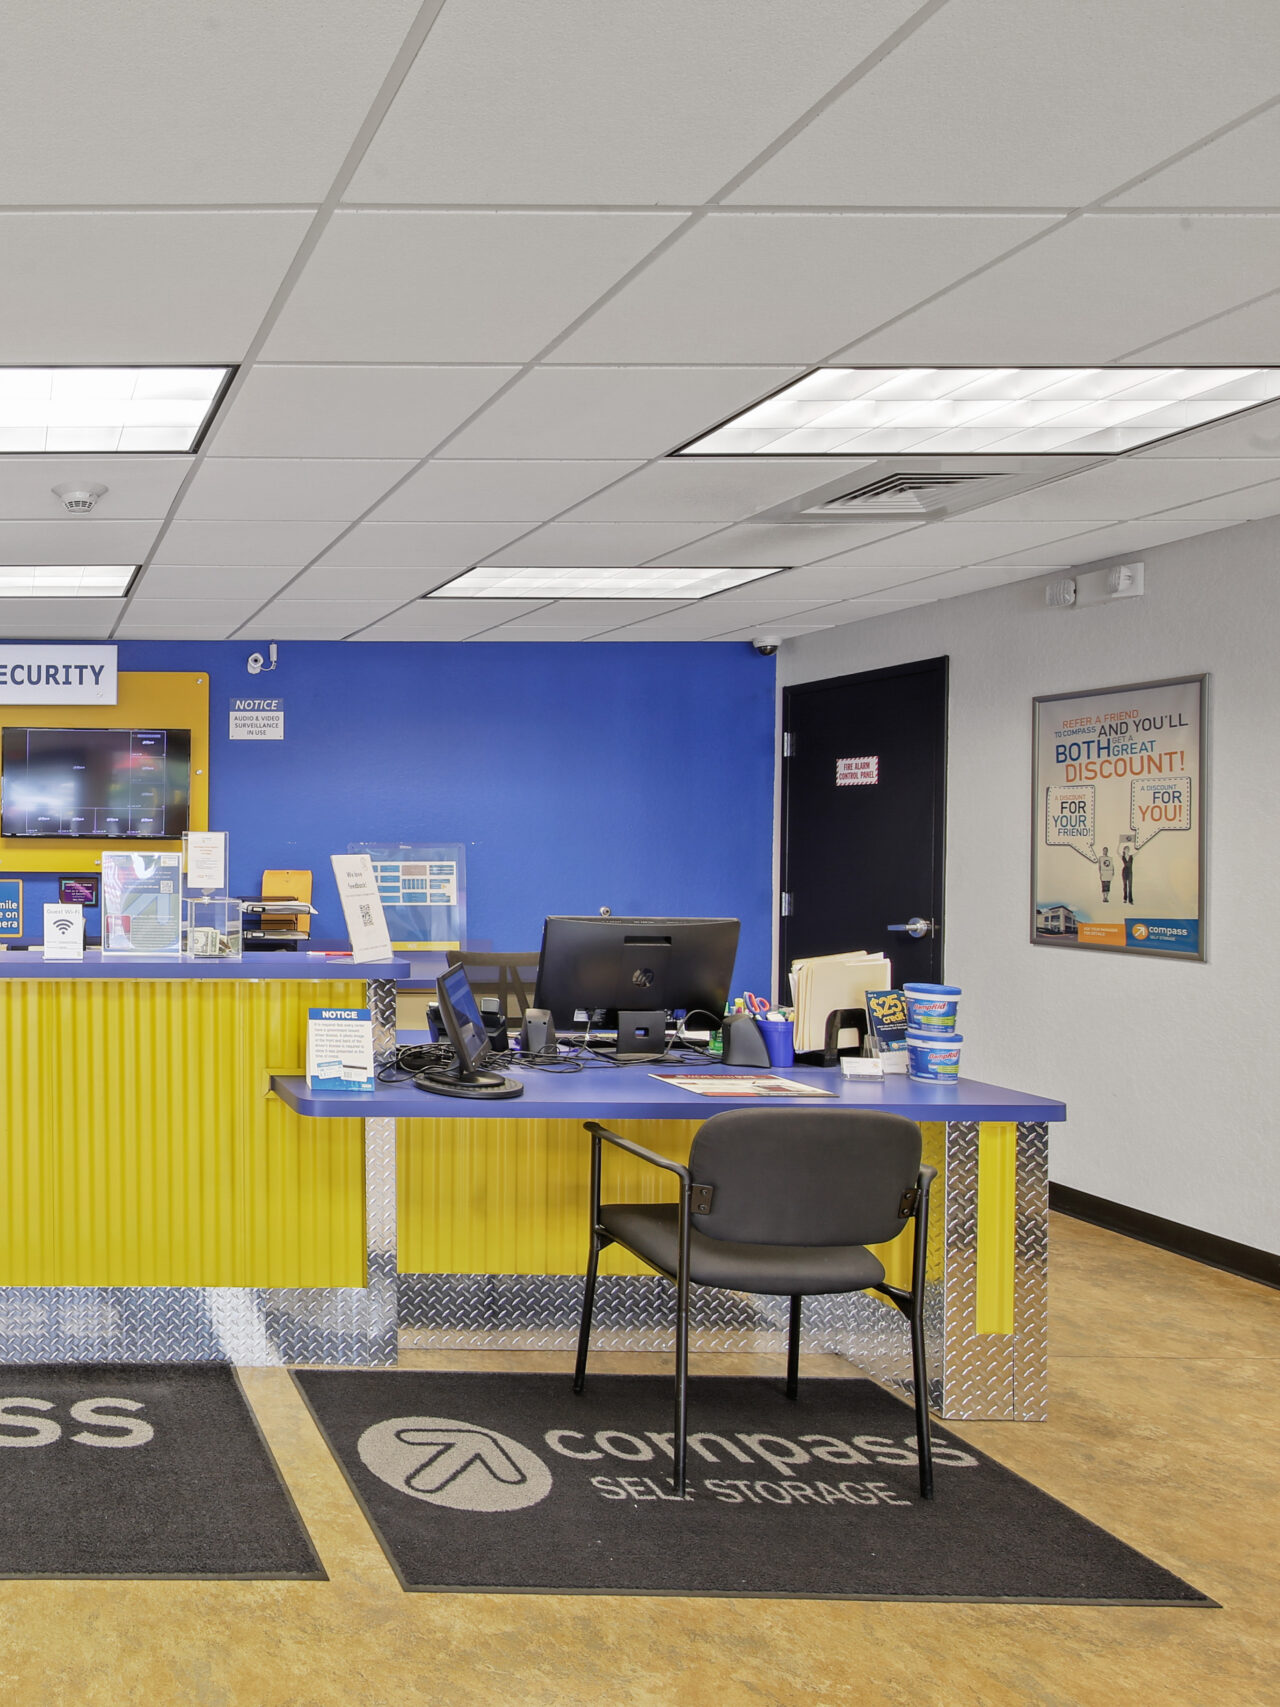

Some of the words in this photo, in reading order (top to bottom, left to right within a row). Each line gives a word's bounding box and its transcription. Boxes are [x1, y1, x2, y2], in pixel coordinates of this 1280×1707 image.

[235, 700, 278, 710] NOTICE
[1062, 716, 1092, 728] REFER
[1104, 710, 1139, 722] FRIEND
[1062, 726, 1096, 736] COMPASS
[1098, 722, 1128, 738] AND
[1133, 713, 1189, 732] YOU'LL
[1112, 736, 1126, 744] GET
[1056, 738, 1111, 764] BOTH
[1112, 740, 1156, 756] GREAT
[1065, 750, 1184, 782] DISCOUNT!
[1152, 790, 1182, 804] FOR
[1060, 800, 1086, 814] FOR
[1138, 804, 1183, 822] YOU!
[1053, 815, 1087, 828] YOUR
[1058, 828, 1090, 836] FRIEND!
[1149, 926, 1188, 936] compass
[870, 994, 902, 1019] $25
[913, 1002, 947, 1010] DampRid
[928, 1050, 958, 1060] DampRid
[545, 1429, 979, 1477] compass
[704, 1478, 913, 1506] STORAGE
